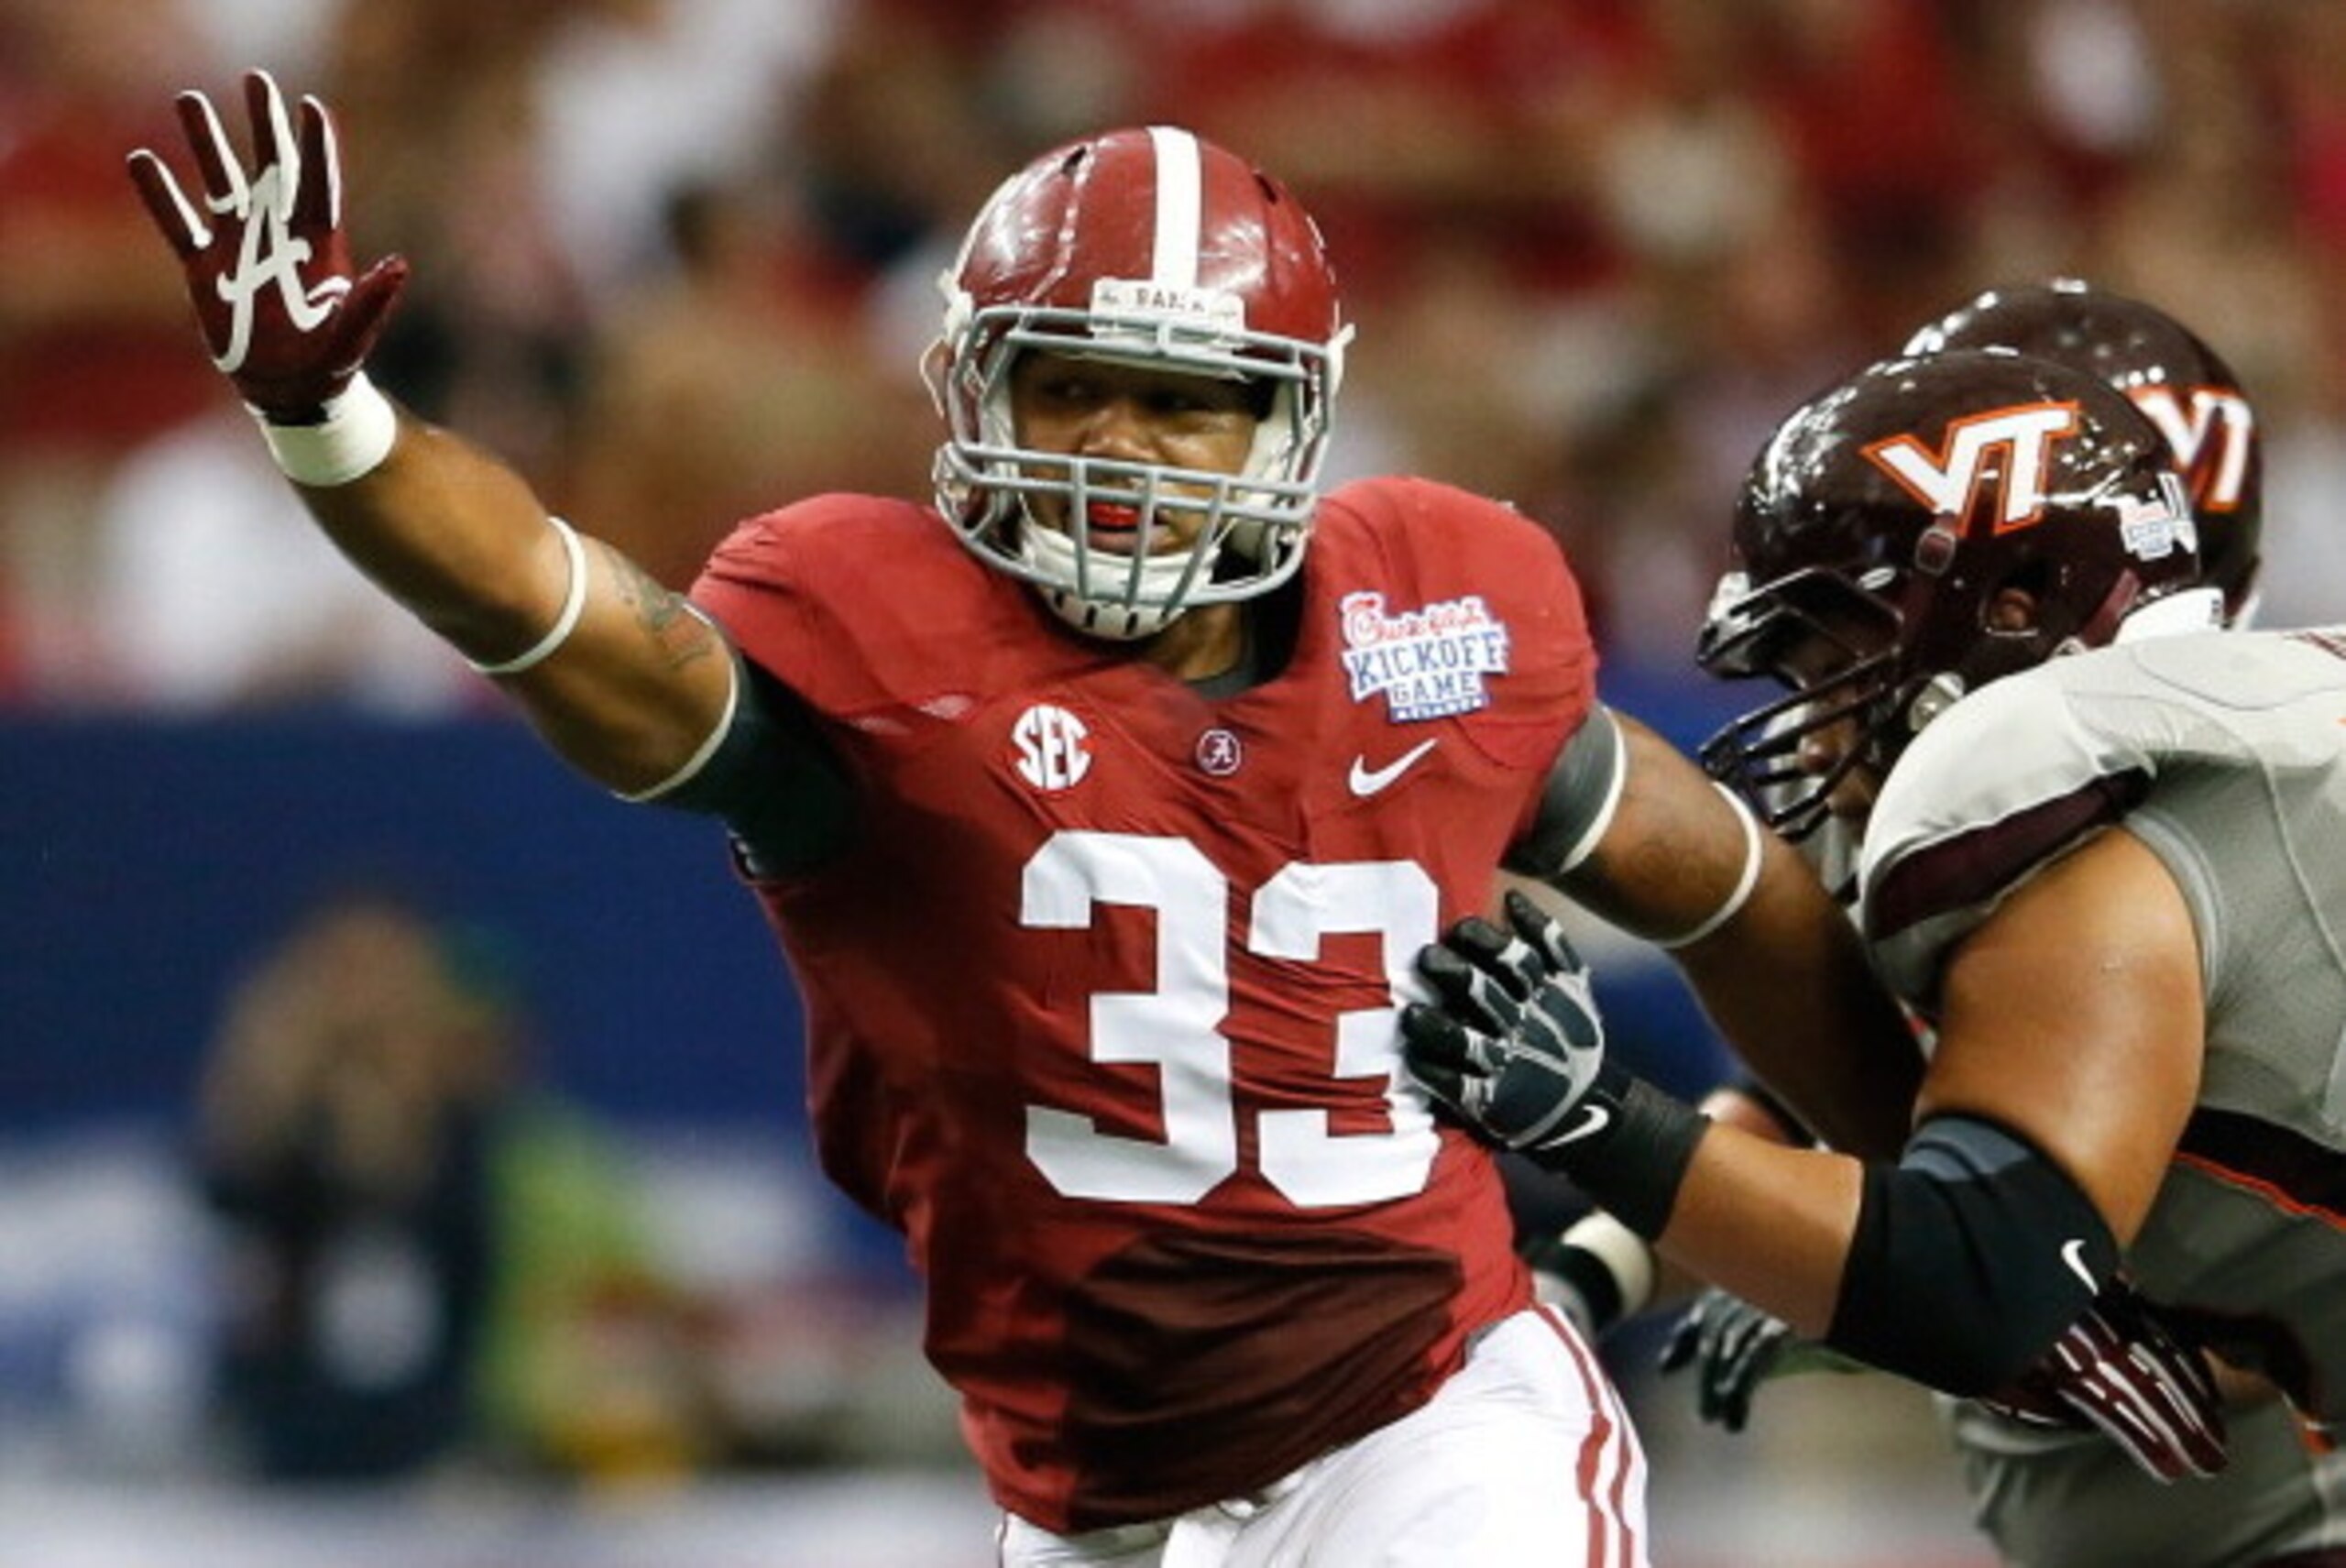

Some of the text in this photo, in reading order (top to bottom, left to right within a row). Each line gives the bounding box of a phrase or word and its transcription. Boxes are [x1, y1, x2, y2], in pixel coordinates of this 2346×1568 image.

[1859, 400, 2080, 537] VT
[1351, 630, 1502, 692] KICKOFF
[1392, 673, 1474, 704] GAME
[1011, 703, 1092, 791] SEC
[1019, 828, 1443, 1209] 33
